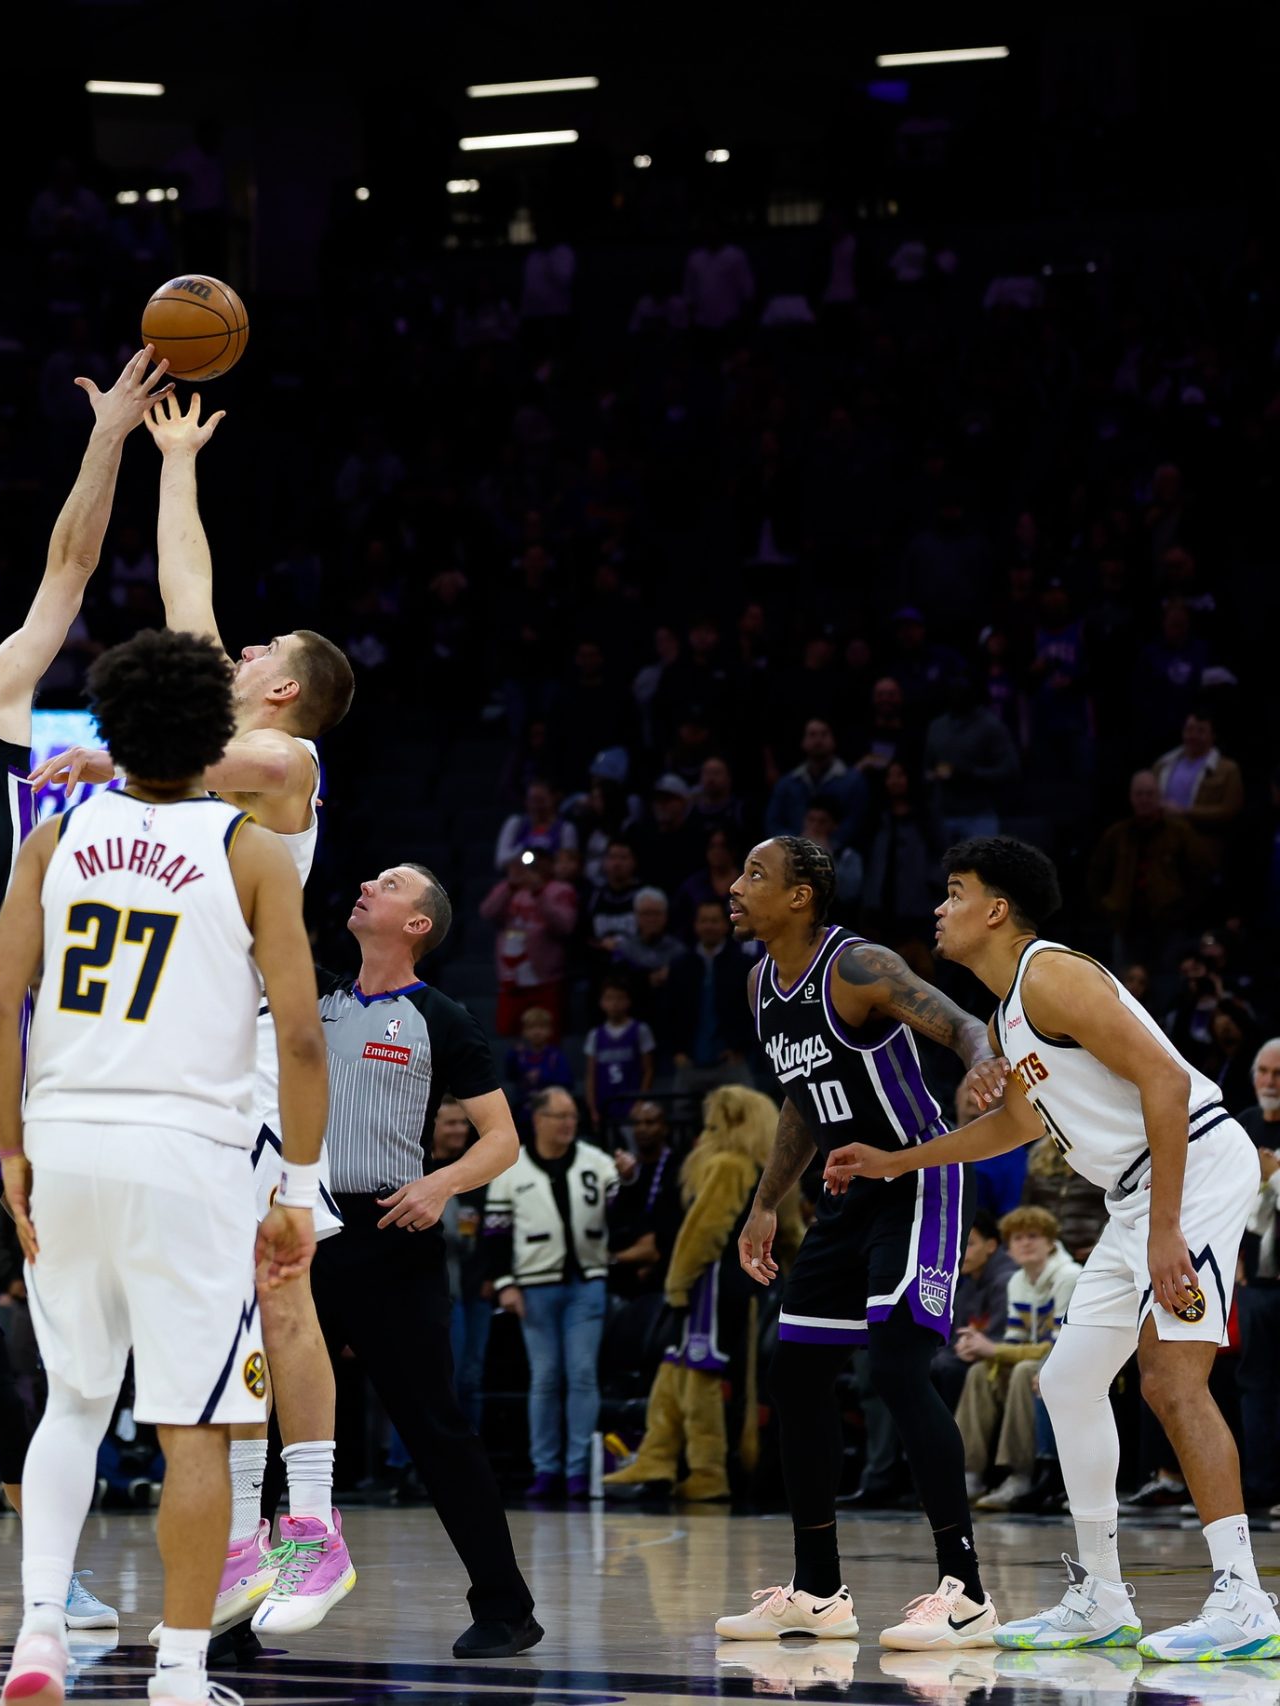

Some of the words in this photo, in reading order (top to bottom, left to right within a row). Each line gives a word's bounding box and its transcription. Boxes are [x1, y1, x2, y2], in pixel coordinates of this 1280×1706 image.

[73, 837, 205, 893] MURRAY
[58, 899, 182, 1023] 27
[364, 1045, 409, 1061] Emirates
[765, 1032, 833, 1084] Kings
[807, 1080, 853, 1124] 10
[581, 1170, 600, 1206] S
